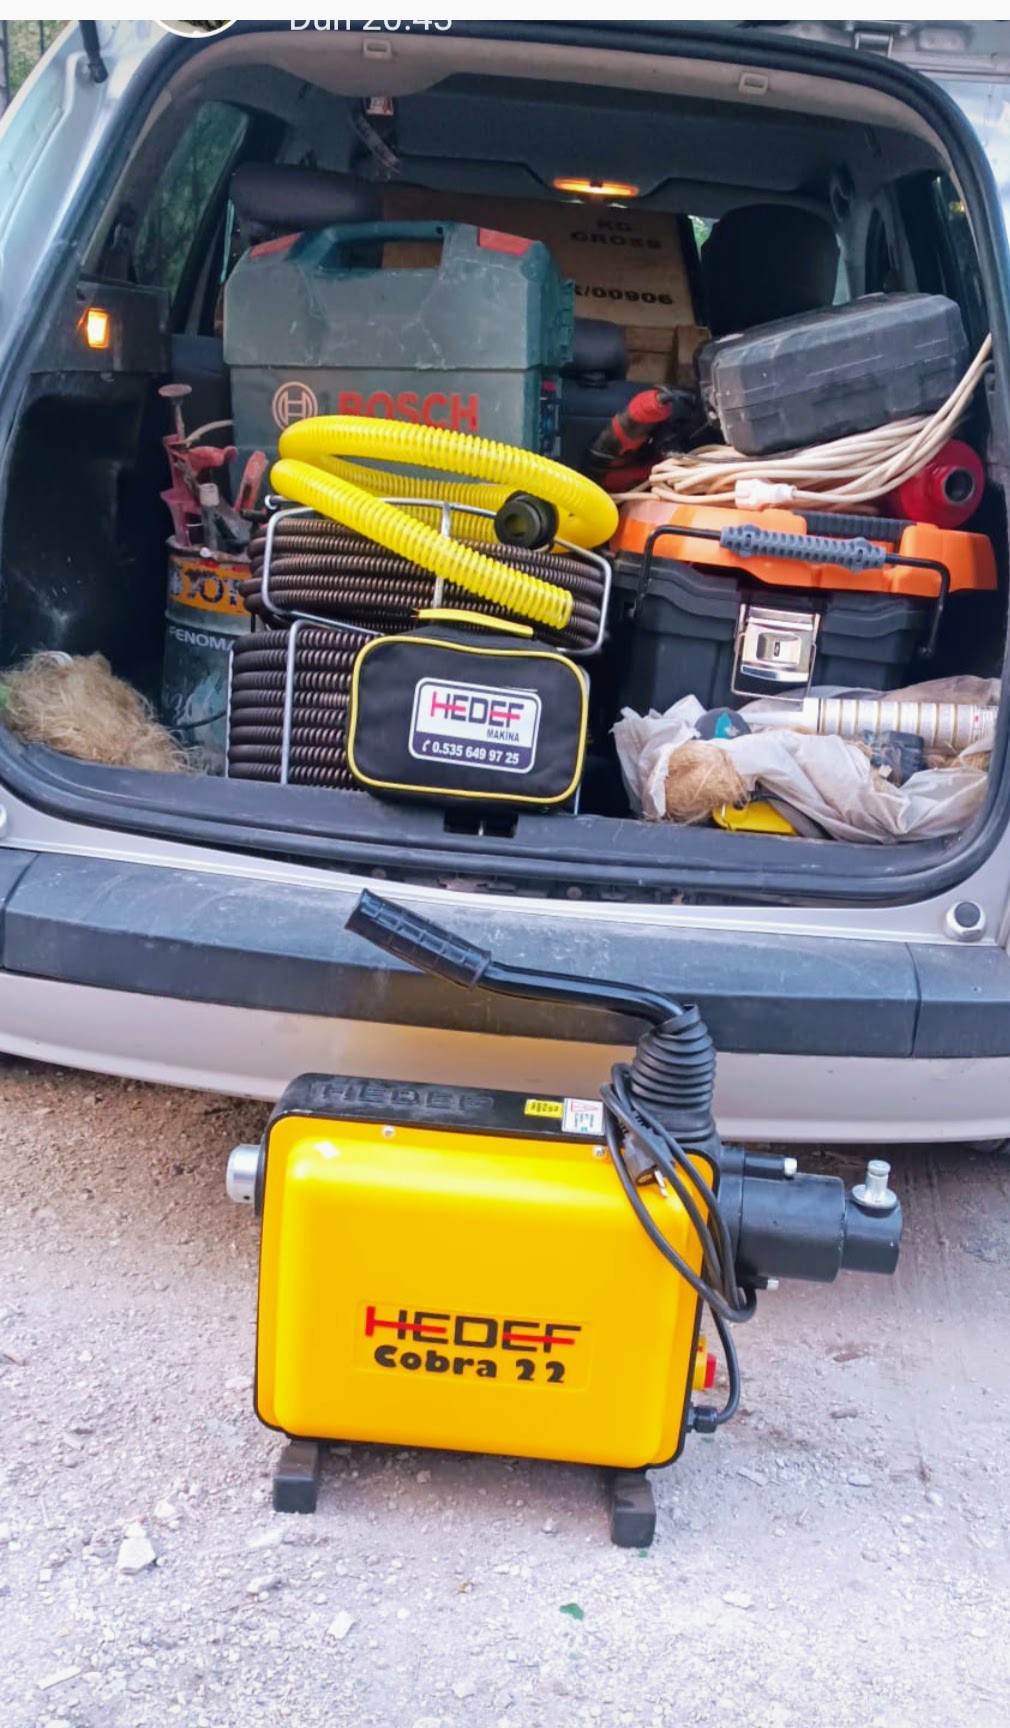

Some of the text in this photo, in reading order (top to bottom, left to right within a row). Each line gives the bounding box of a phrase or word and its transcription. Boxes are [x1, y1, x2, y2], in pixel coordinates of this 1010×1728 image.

[337, 391, 479, 432] BOSCH
[431, 691, 524, 728] HEDEF
[432, 741, 520, 765] 0.535 649 97 25
[365, 1306, 582, 1354] HEDEF
[374, 1345, 498, 1378] Cobra
